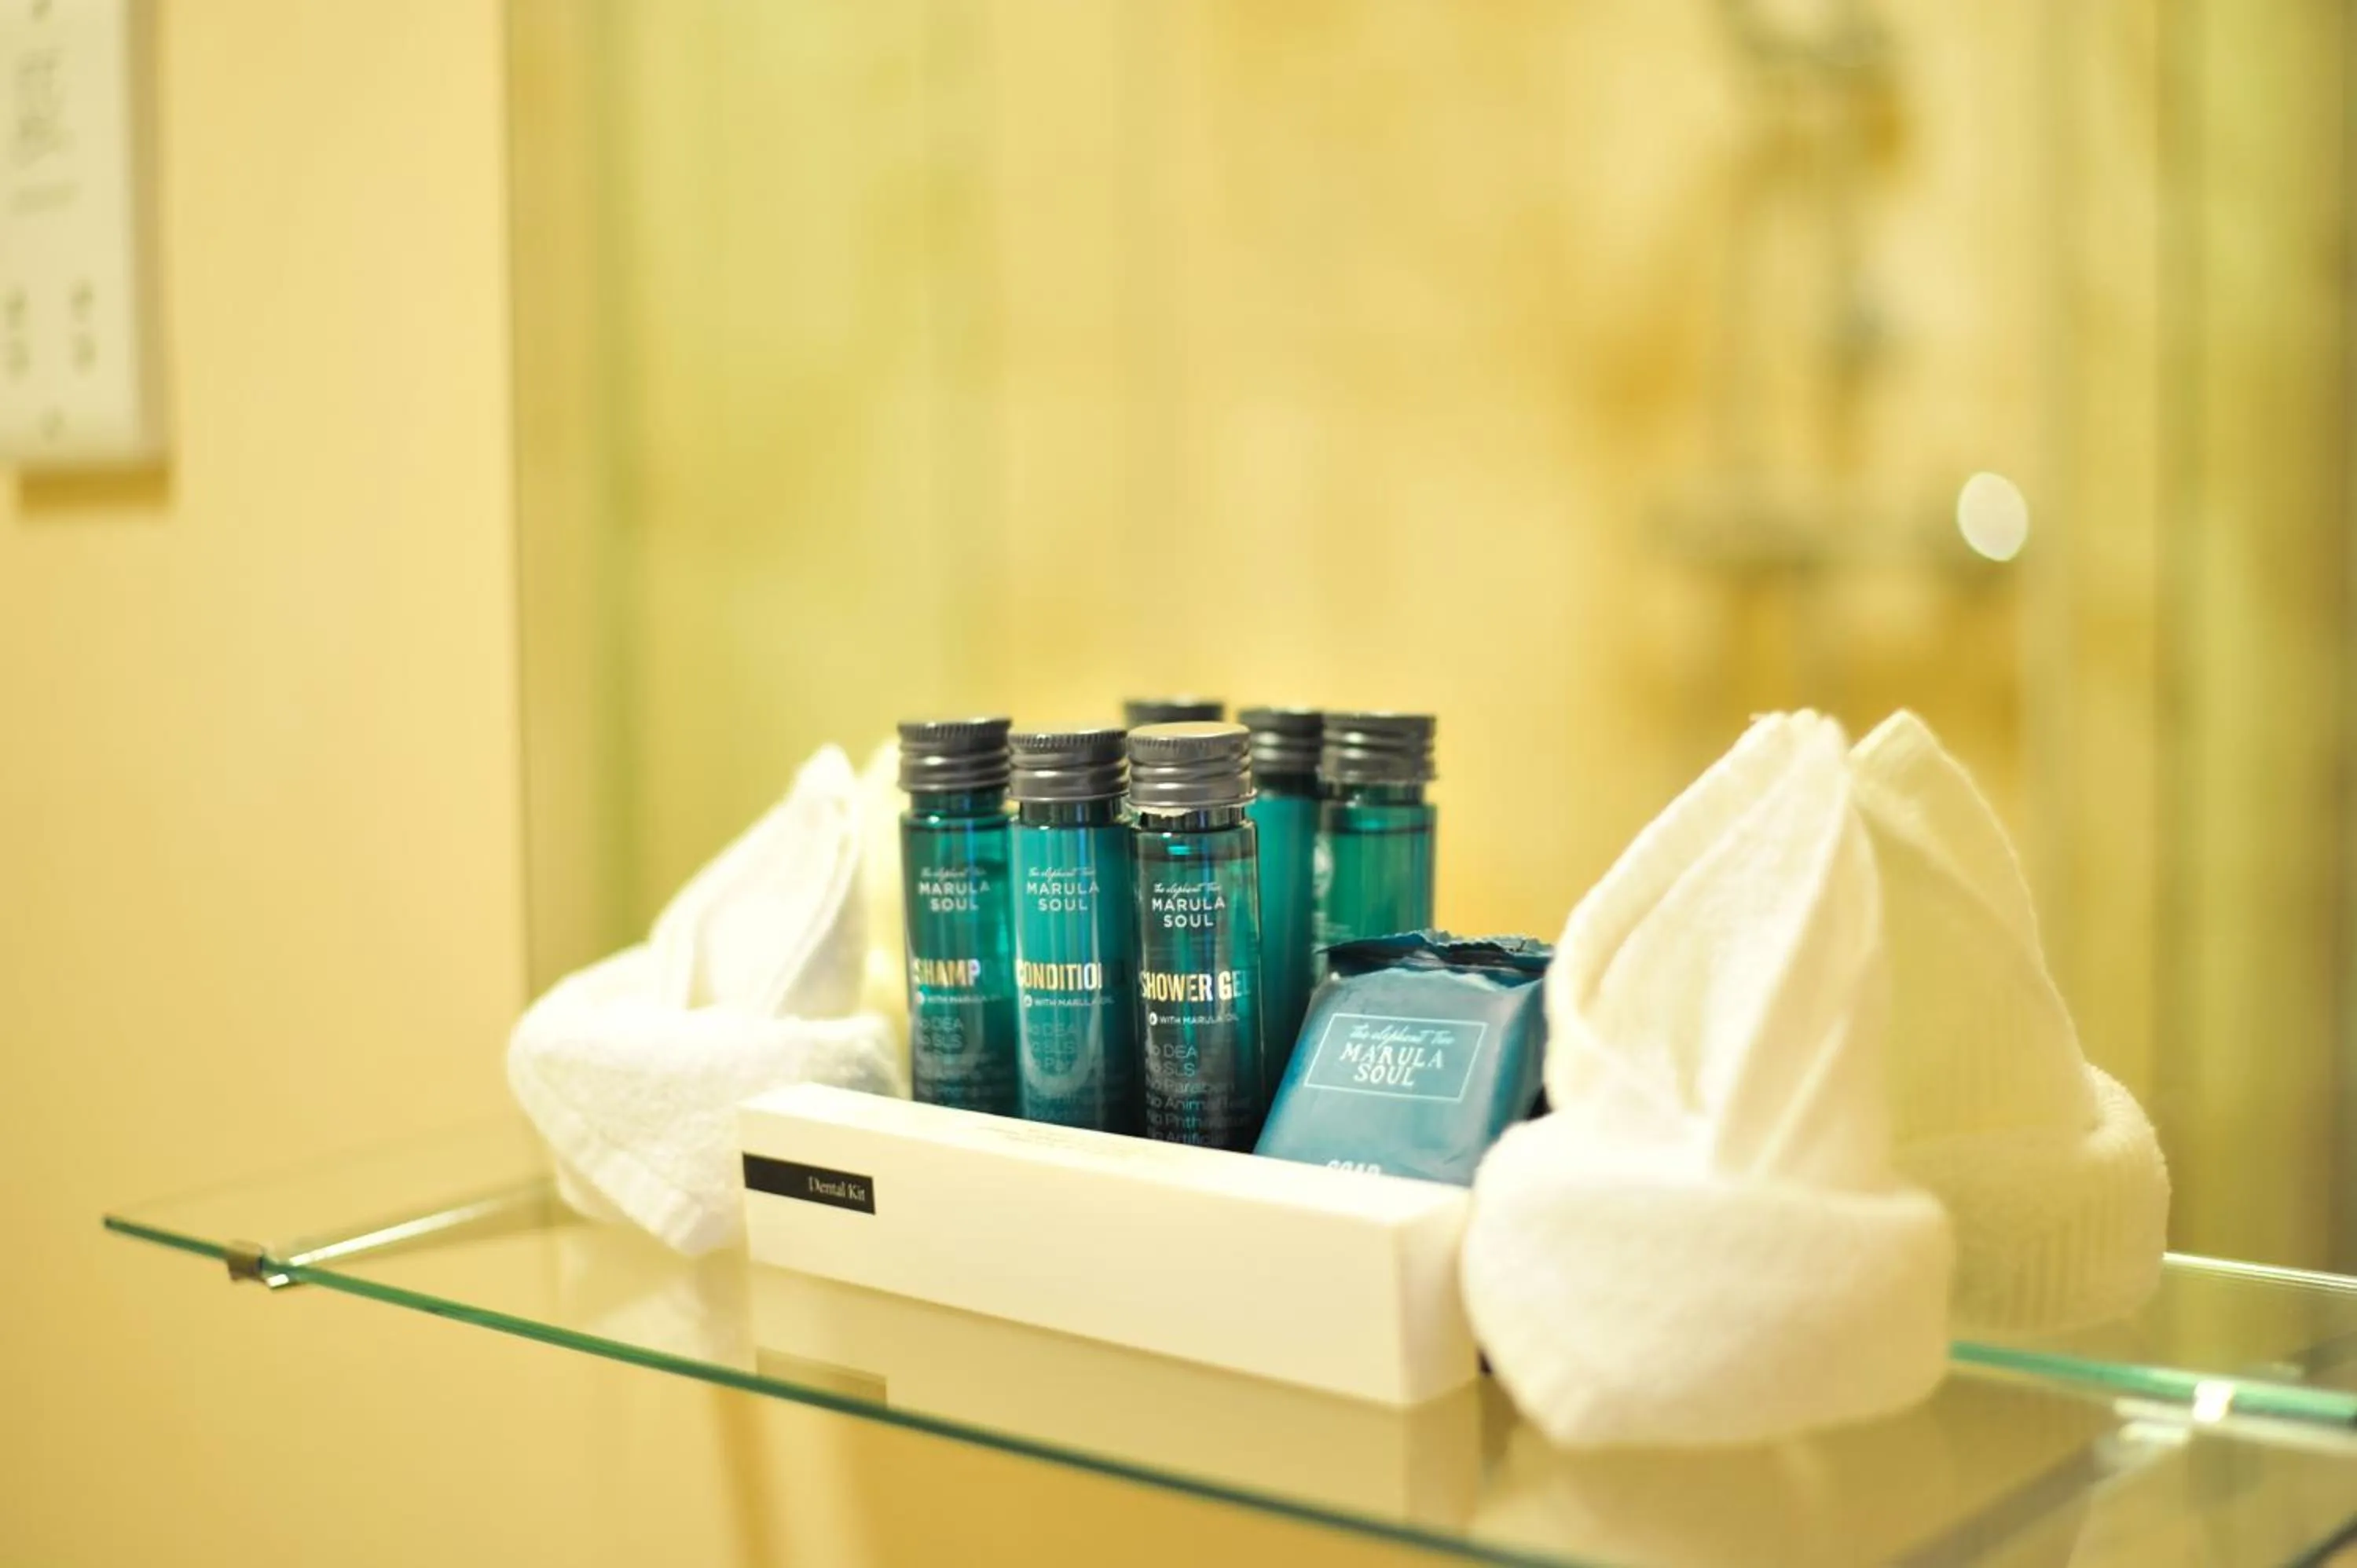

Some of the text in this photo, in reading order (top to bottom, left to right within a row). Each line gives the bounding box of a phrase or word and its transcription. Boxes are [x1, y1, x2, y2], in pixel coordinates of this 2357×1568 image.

[918, 881, 991, 896] MARULA
[1026, 881, 1099, 895] MARULA
[930, 899, 979, 912] SOUL
[1038, 899, 1088, 911] SOUL
[1152, 896, 1226, 912] MARULA
[1164, 914, 1214, 928] SOUL
[1142, 970, 1214, 1002] SHOWER
[1164, 1043, 1197, 1058] DEA
[1339, 1042, 1444, 1068] MARULA
[1164, 1061, 1195, 1077] SLS
[1353, 1063, 1415, 1086] SOUL
[808, 1176, 865, 1201] Dental Kit
